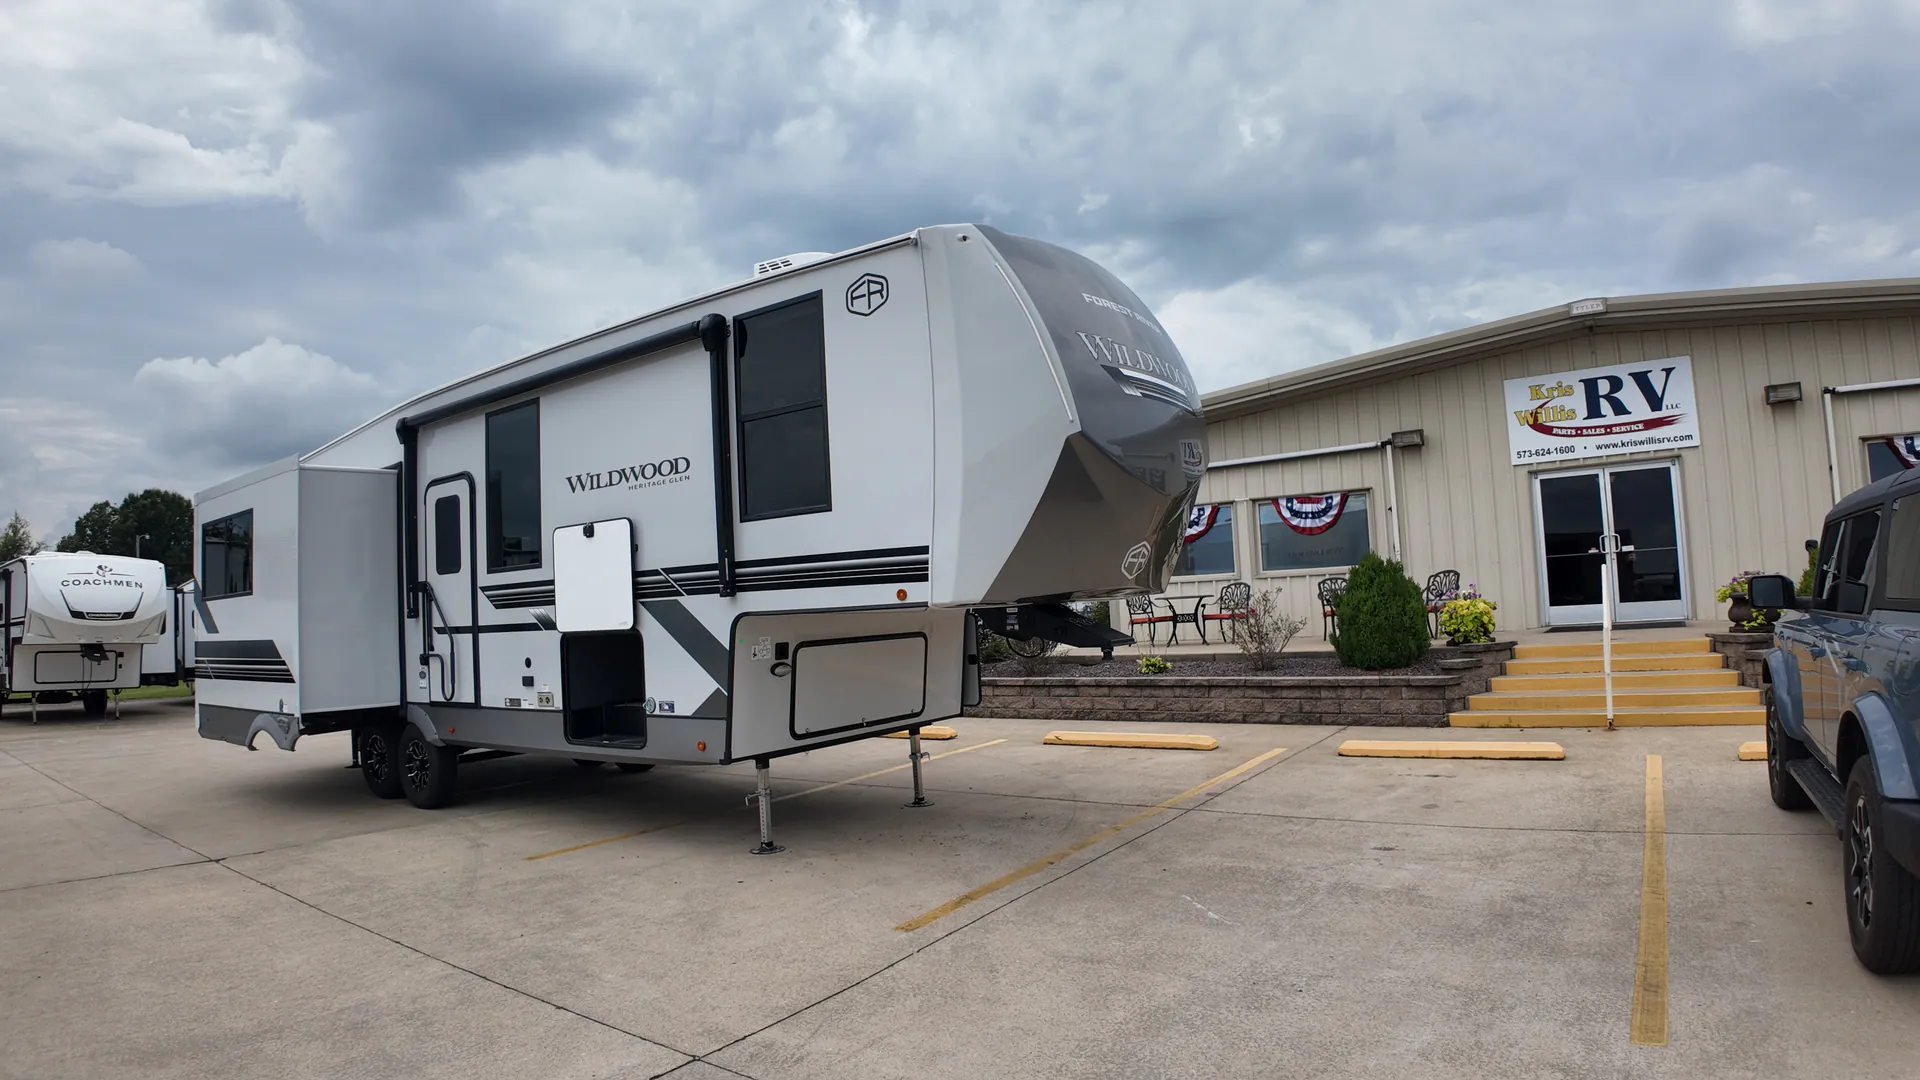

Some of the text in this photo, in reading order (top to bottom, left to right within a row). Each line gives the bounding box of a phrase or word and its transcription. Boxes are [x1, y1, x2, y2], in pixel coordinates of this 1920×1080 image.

[1081, 292, 1133, 318] FOREST
[1075, 331, 1195, 394] WILDWOOD
[1528, 381, 1575, 401] Kris
[1578, 366, 1682, 421] RV LLC
[1513, 404, 1578, 427] Willis
[1552, 423, 1644, 436] PARTS SALES SERVICE
[1516, 434, 1693, 459] 573-624-1600 www.kriswillisrv.com
[565, 456, 690, 493] WILDWOOD
[628, 475, 690, 490] HERITAGE GLEN
[61, 579, 143, 588] COACHMEN
